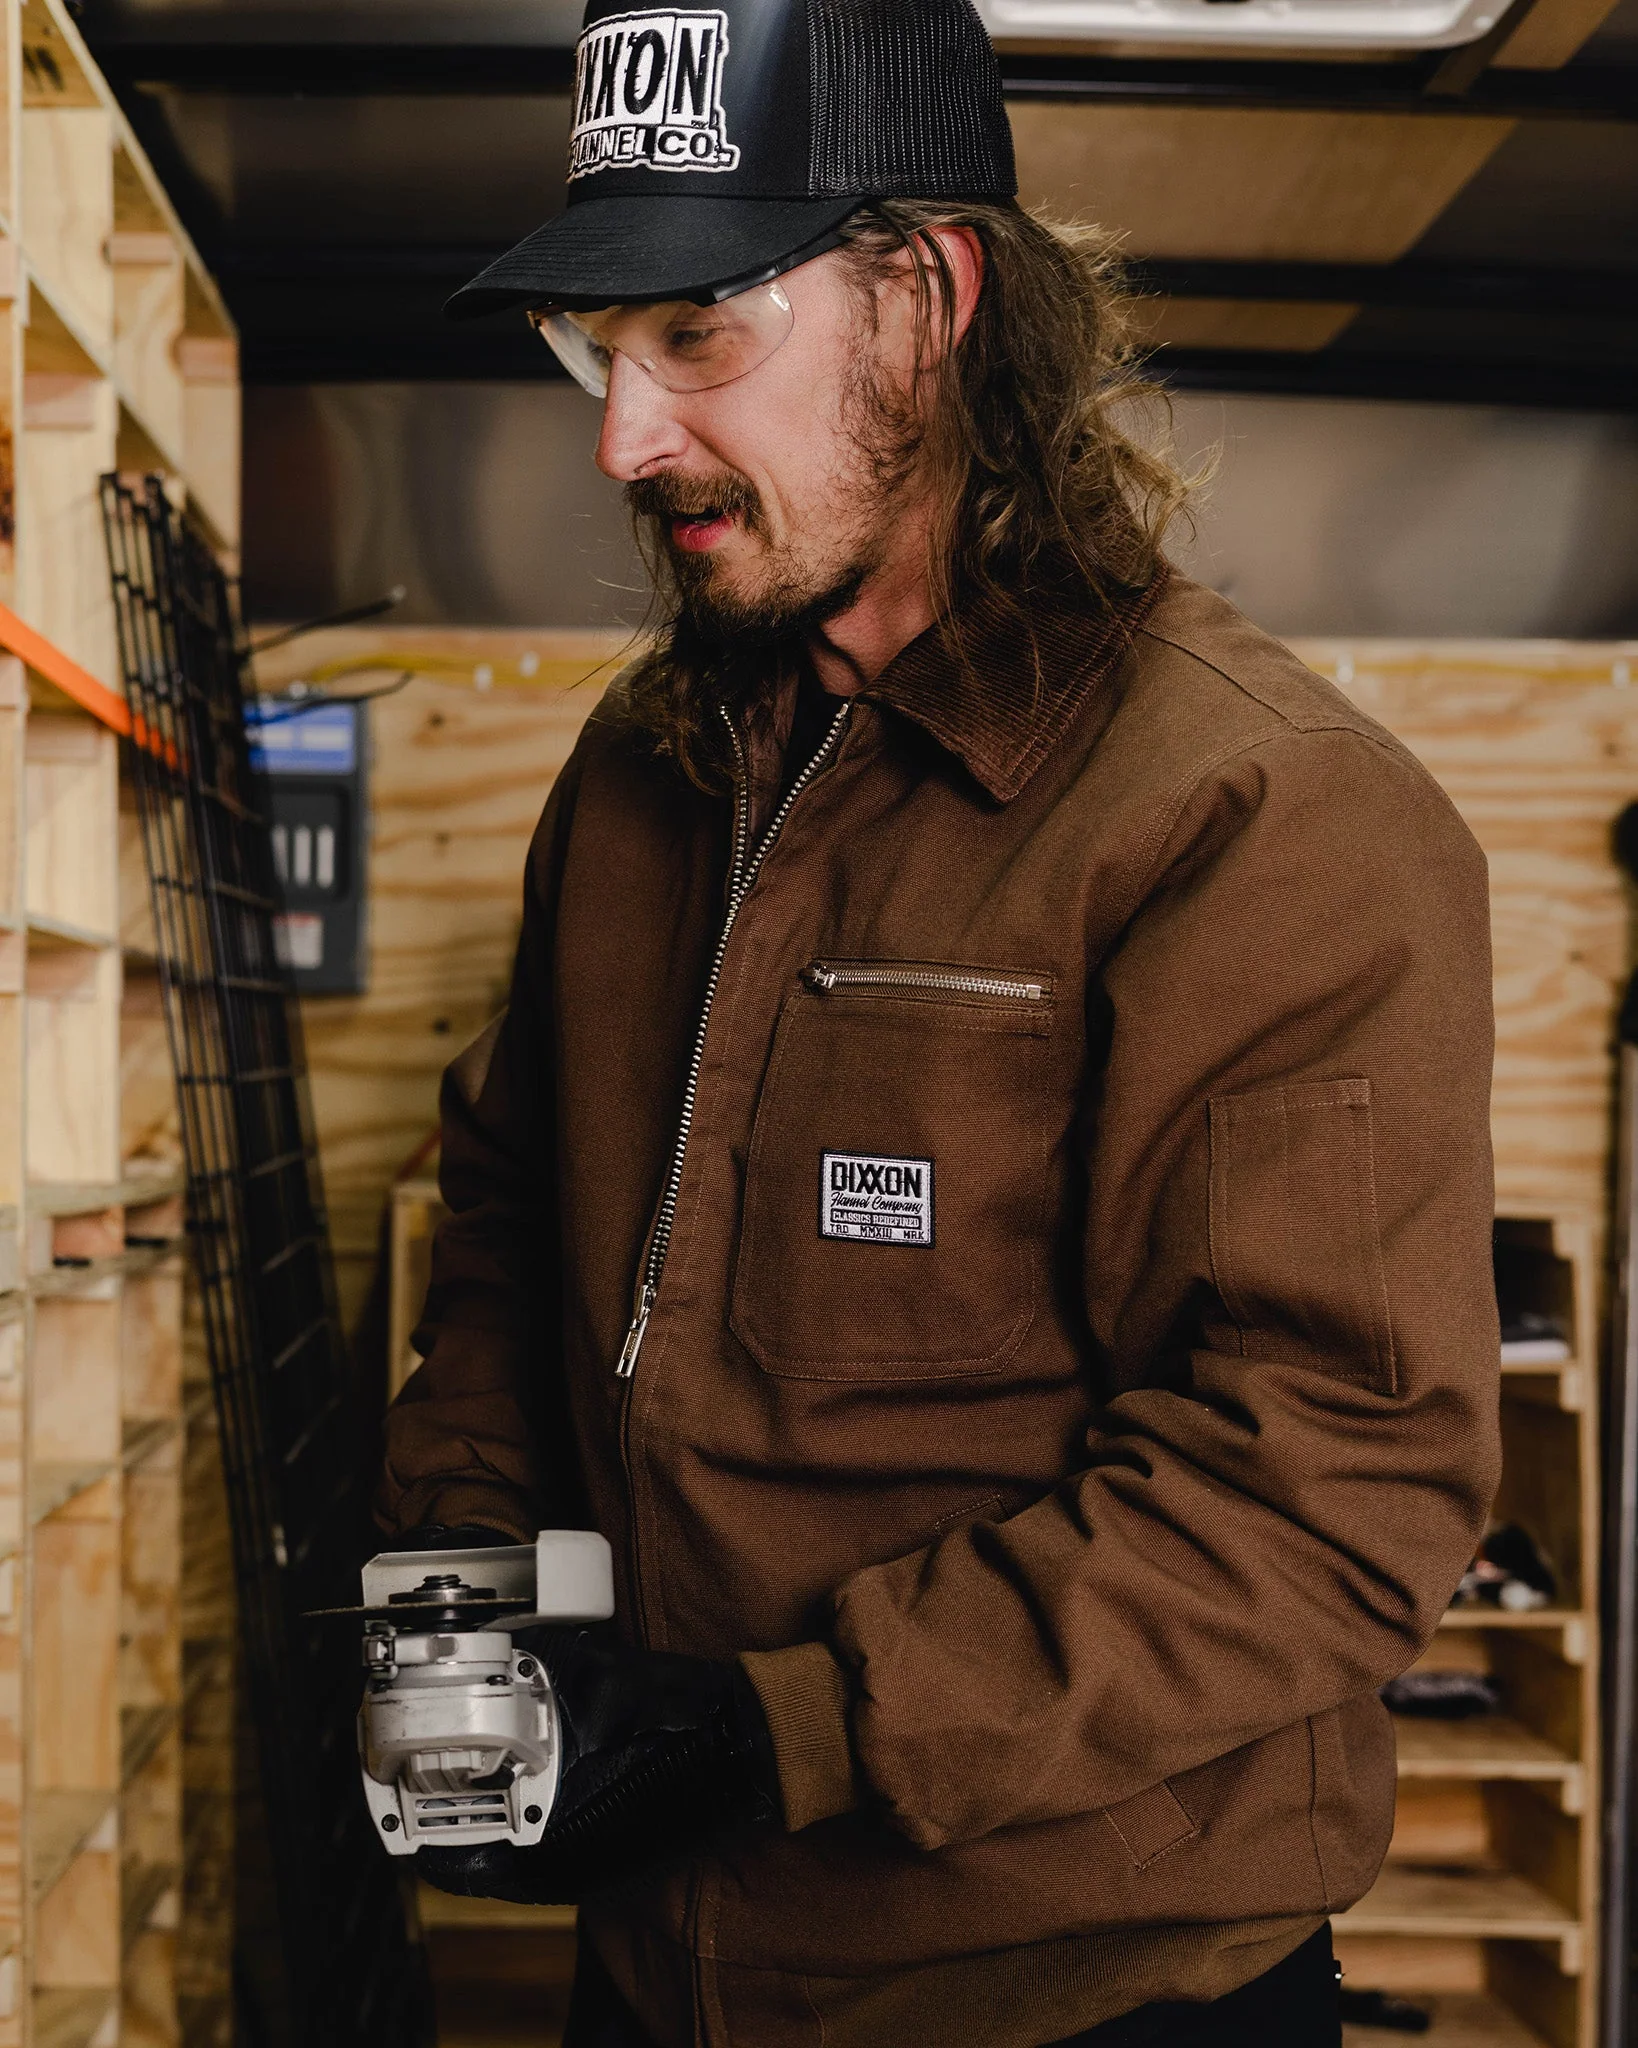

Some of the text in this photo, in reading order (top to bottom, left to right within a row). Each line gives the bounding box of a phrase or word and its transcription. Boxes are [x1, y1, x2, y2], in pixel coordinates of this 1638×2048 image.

[831, 1161, 922, 1198] DIXXON
[830, 1192, 923, 1214] Flannel Company
[832, 1210, 920, 1228] CLASSICS REDEFINED
[830, 1224, 849, 1233] TRD
[903, 1230, 924, 1240] MRK
